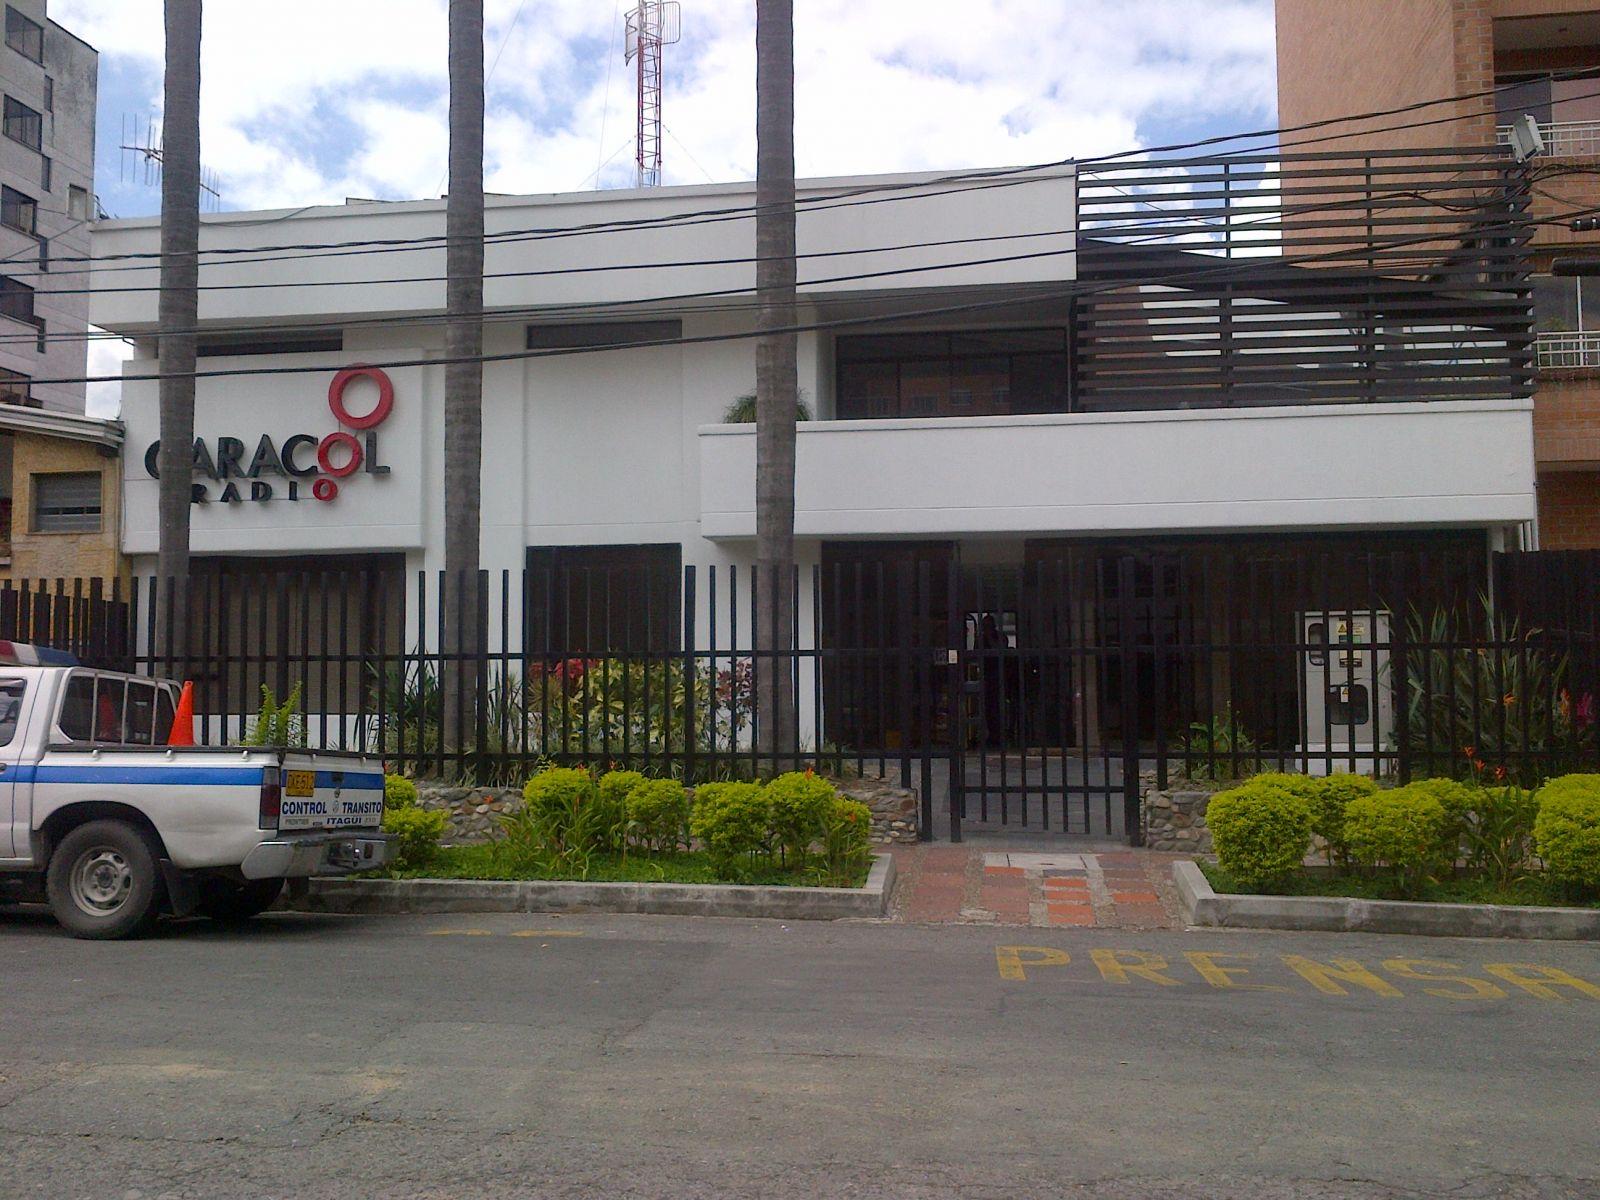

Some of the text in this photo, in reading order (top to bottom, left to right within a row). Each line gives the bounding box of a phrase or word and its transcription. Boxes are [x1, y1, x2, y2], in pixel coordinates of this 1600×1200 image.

[191, 478, 338, 504] RADIO
[282, 801, 382, 815] CONTROL TRANSITO
[326, 817, 362, 826] ITAGUI
[995, 945, 1600, 1001] PRENSA
